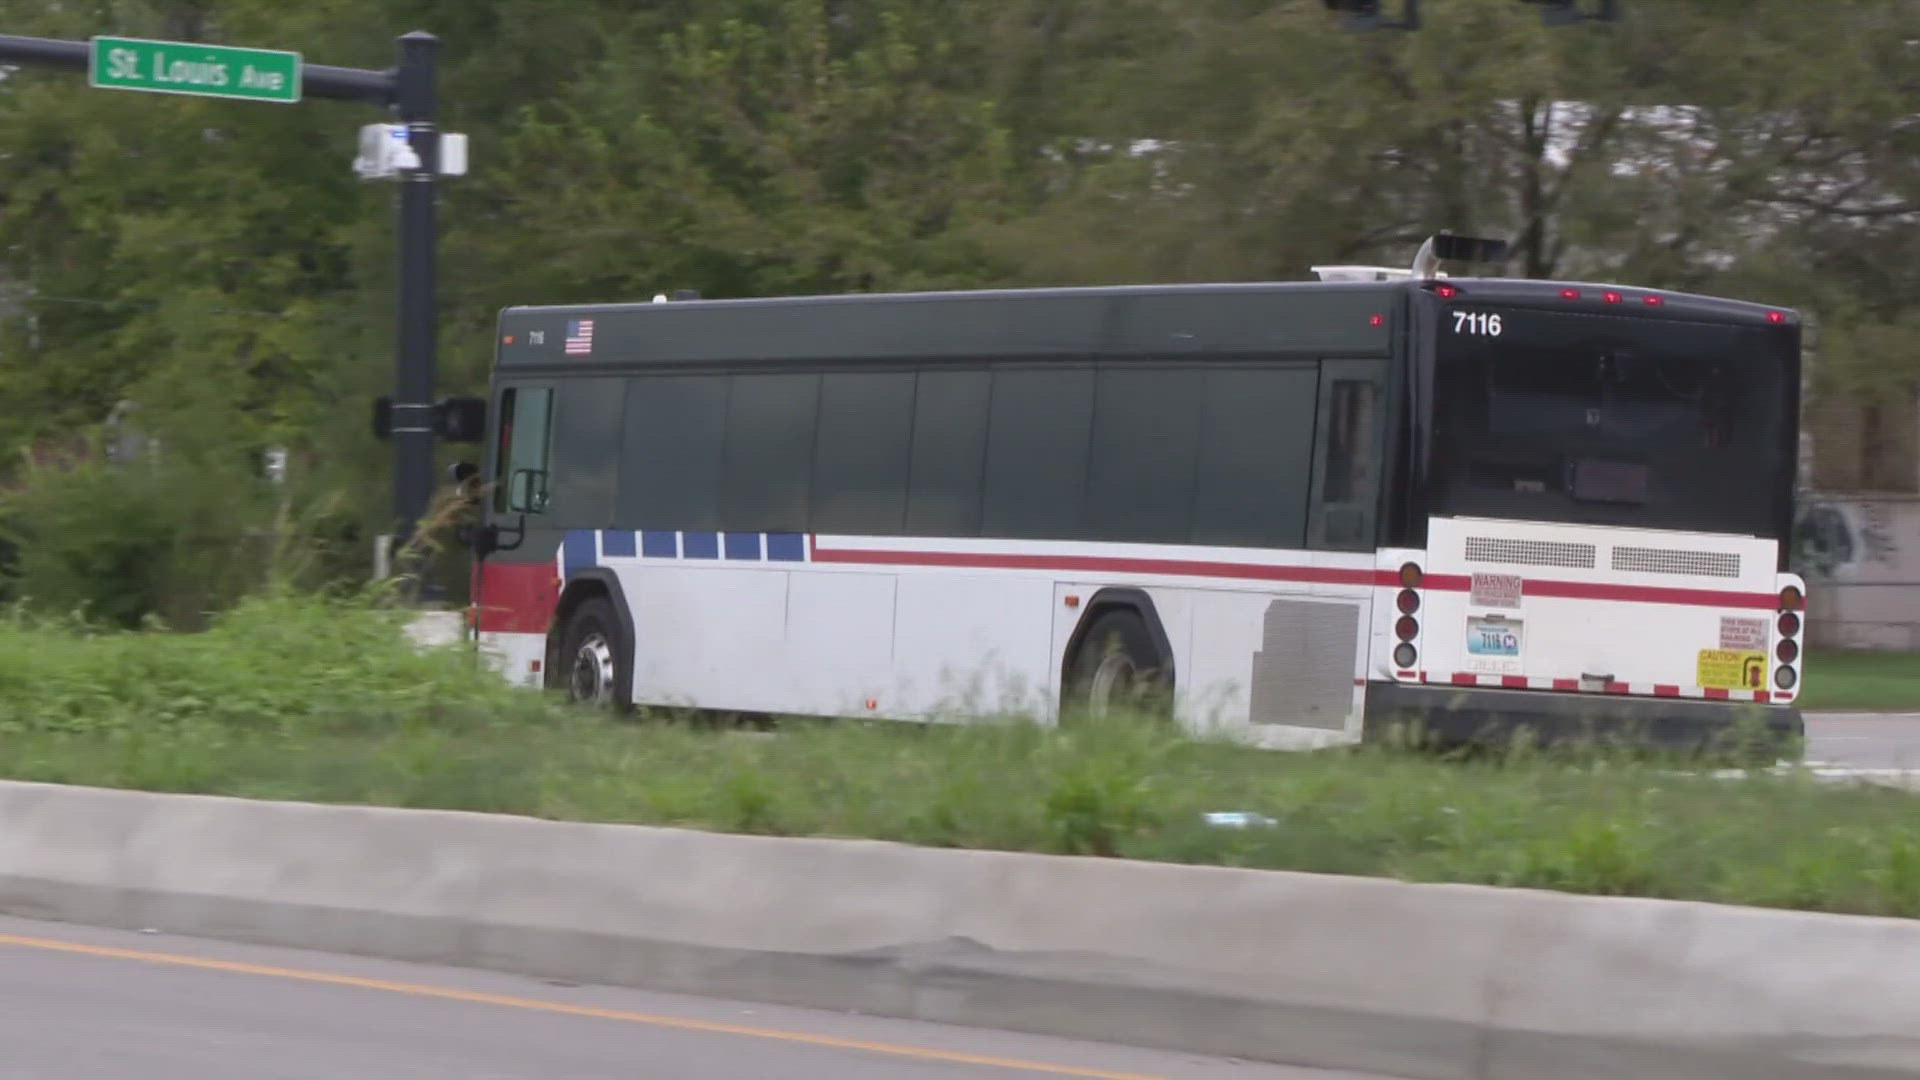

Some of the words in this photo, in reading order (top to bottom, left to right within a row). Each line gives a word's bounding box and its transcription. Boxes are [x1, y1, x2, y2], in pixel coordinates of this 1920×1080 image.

[153, 52, 229, 86] Louis
[239, 64, 285, 90] Ave
[1453, 310, 1502, 336] 7116
[1473, 574, 1521, 588] WARNING
